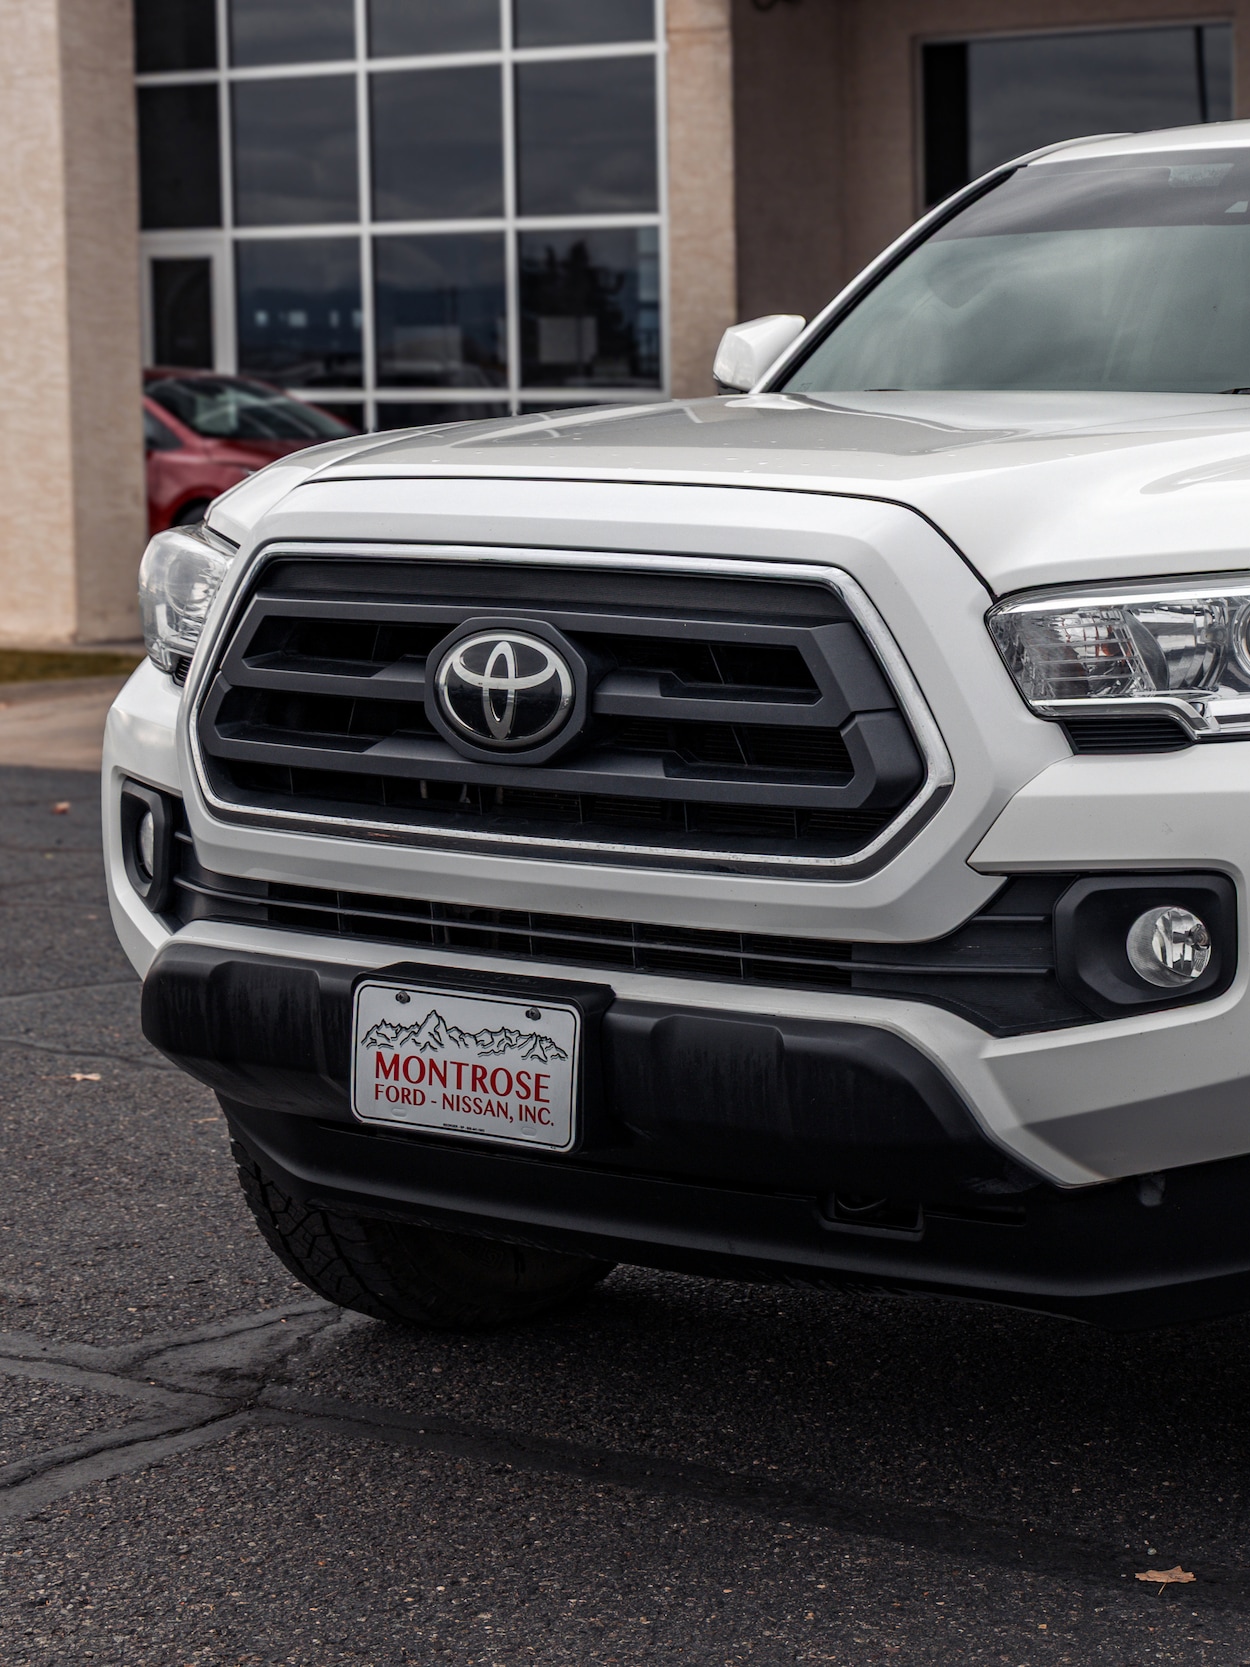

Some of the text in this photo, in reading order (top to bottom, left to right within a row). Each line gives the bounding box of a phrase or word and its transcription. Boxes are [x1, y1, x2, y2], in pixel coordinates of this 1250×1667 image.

[375, 1051, 551, 1103] MONTROSE
[374, 1084, 426, 1106] FORD
[442, 1093, 514, 1123] NISSAN,
[518, 1104, 555, 1127] INC.
